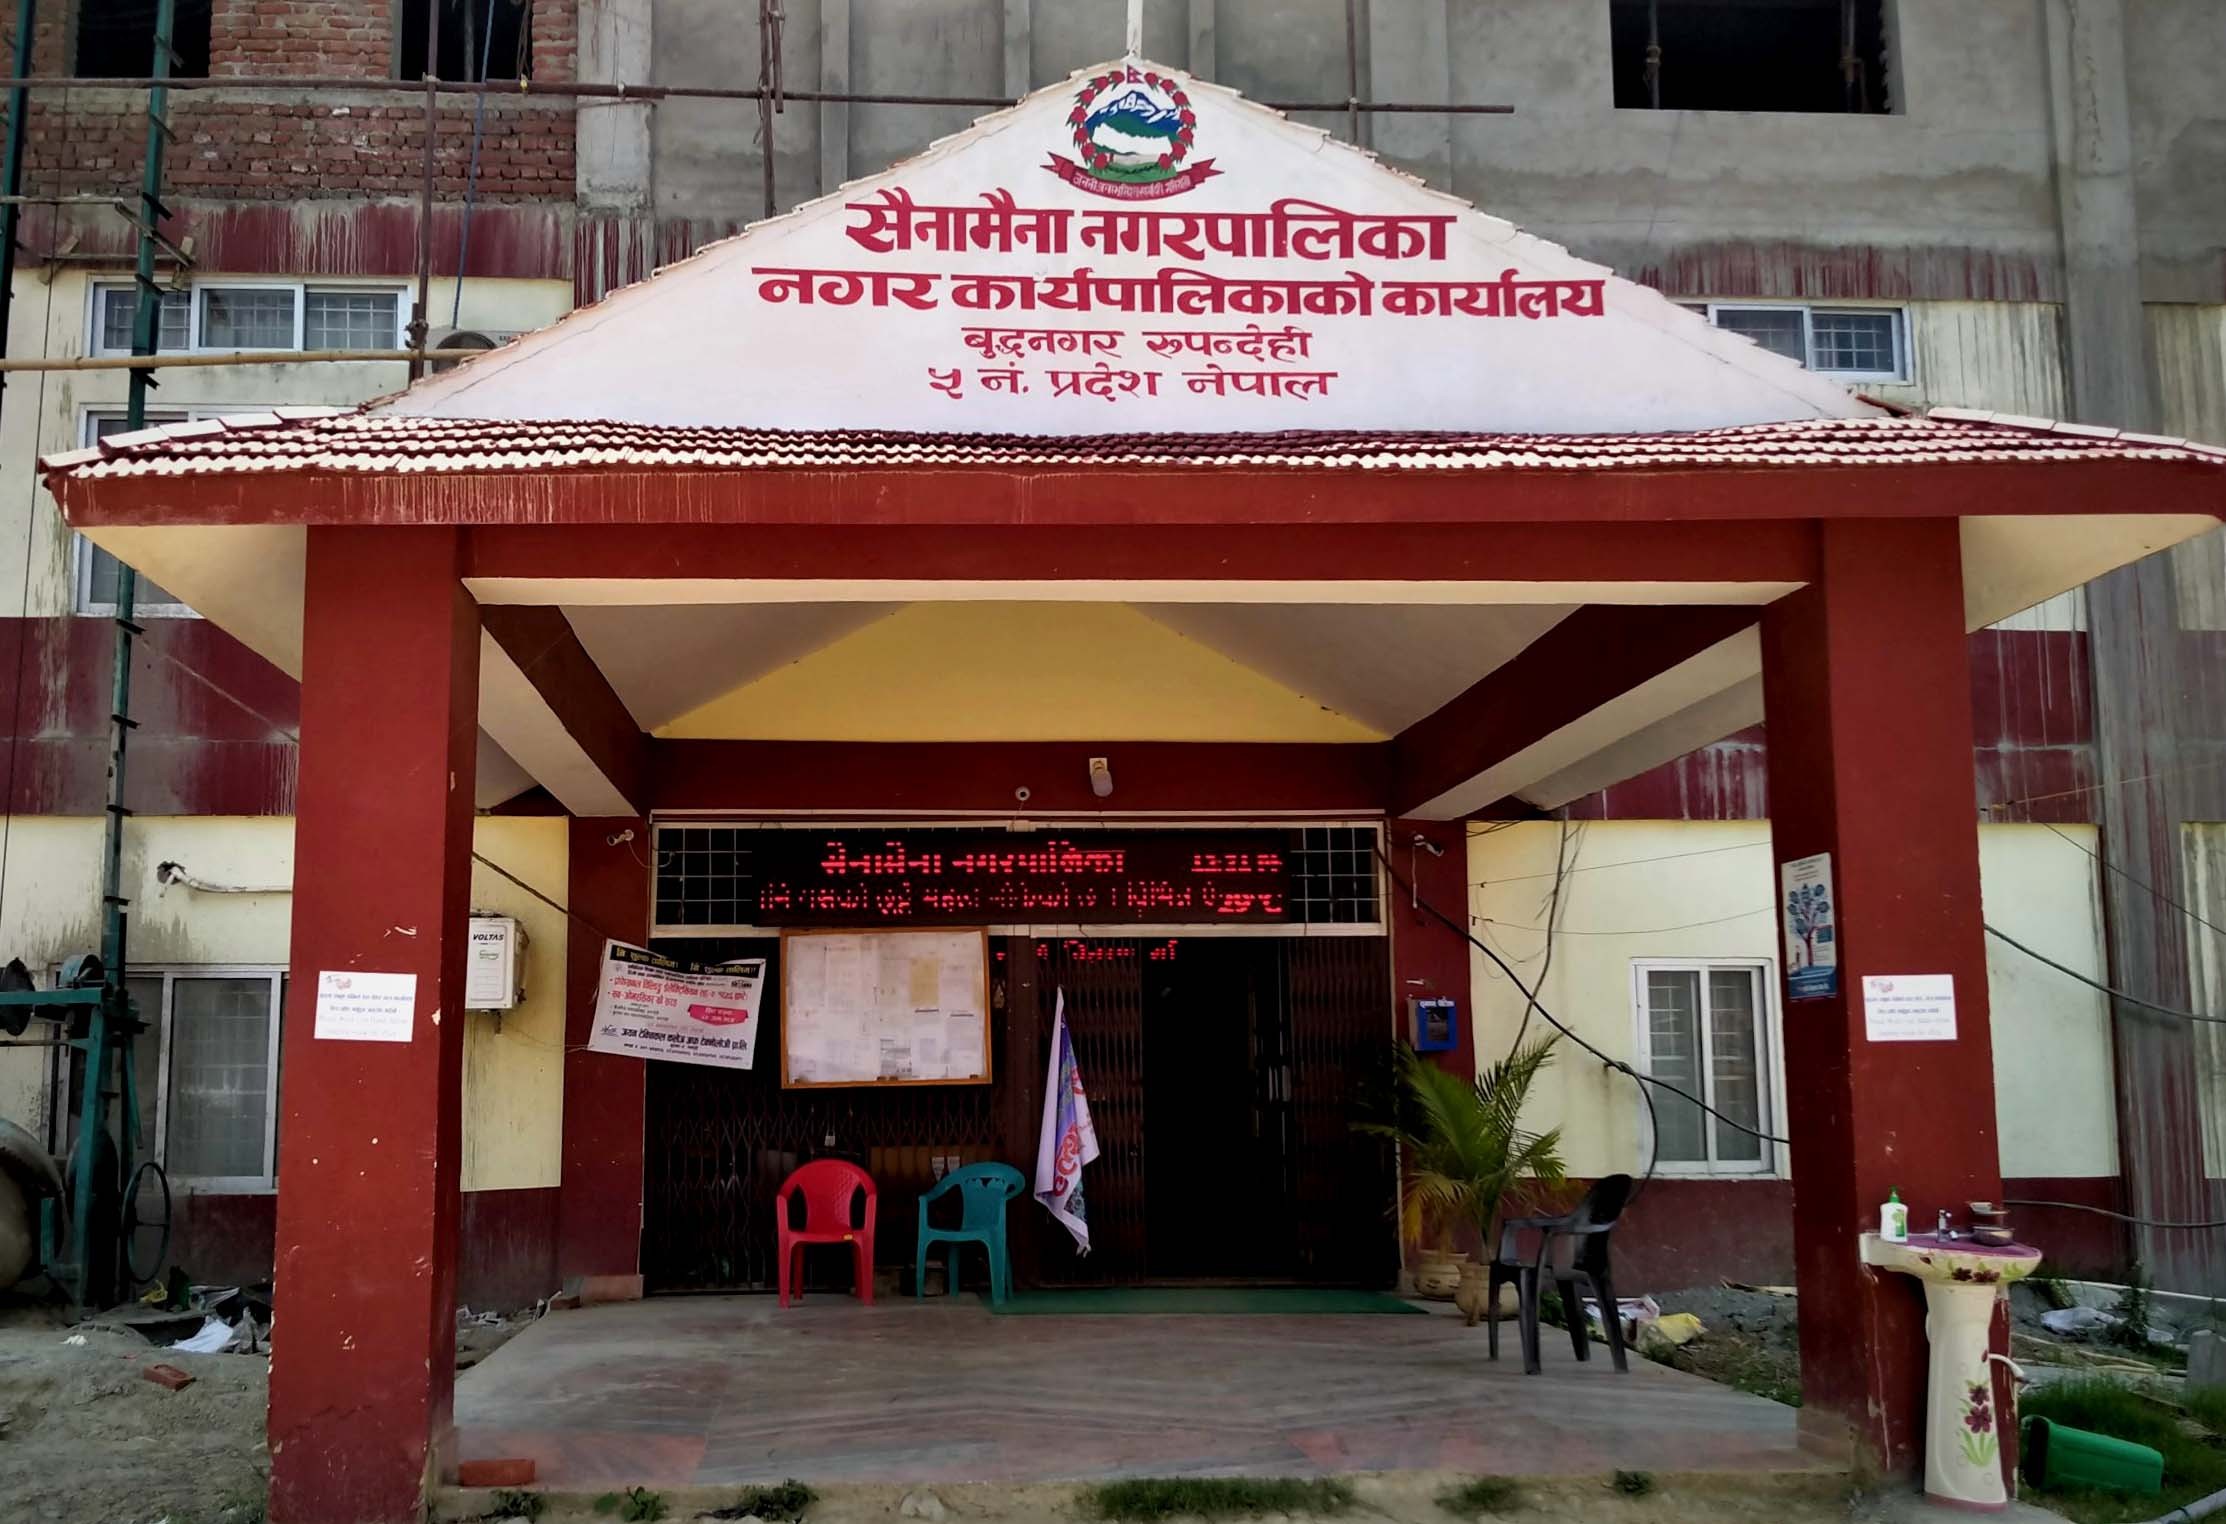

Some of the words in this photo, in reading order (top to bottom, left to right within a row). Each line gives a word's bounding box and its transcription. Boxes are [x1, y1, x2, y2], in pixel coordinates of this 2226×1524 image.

[845, 187, 1073, 255] सैनामैना
[1081, 198, 1457, 262] नगरपालिका
[751, 266, 941, 311] नगर
[950, 267, 1375, 317] कार्यपालिकाको
[1381, 268, 1606, 320] कार्यालय
[961, 326, 1125, 359] बुद्धनगर
[978, 361, 1029, 395] नं.
[1045, 361, 1163, 403] प्रदेश
[1181, 365, 1339, 401] नेपाल
